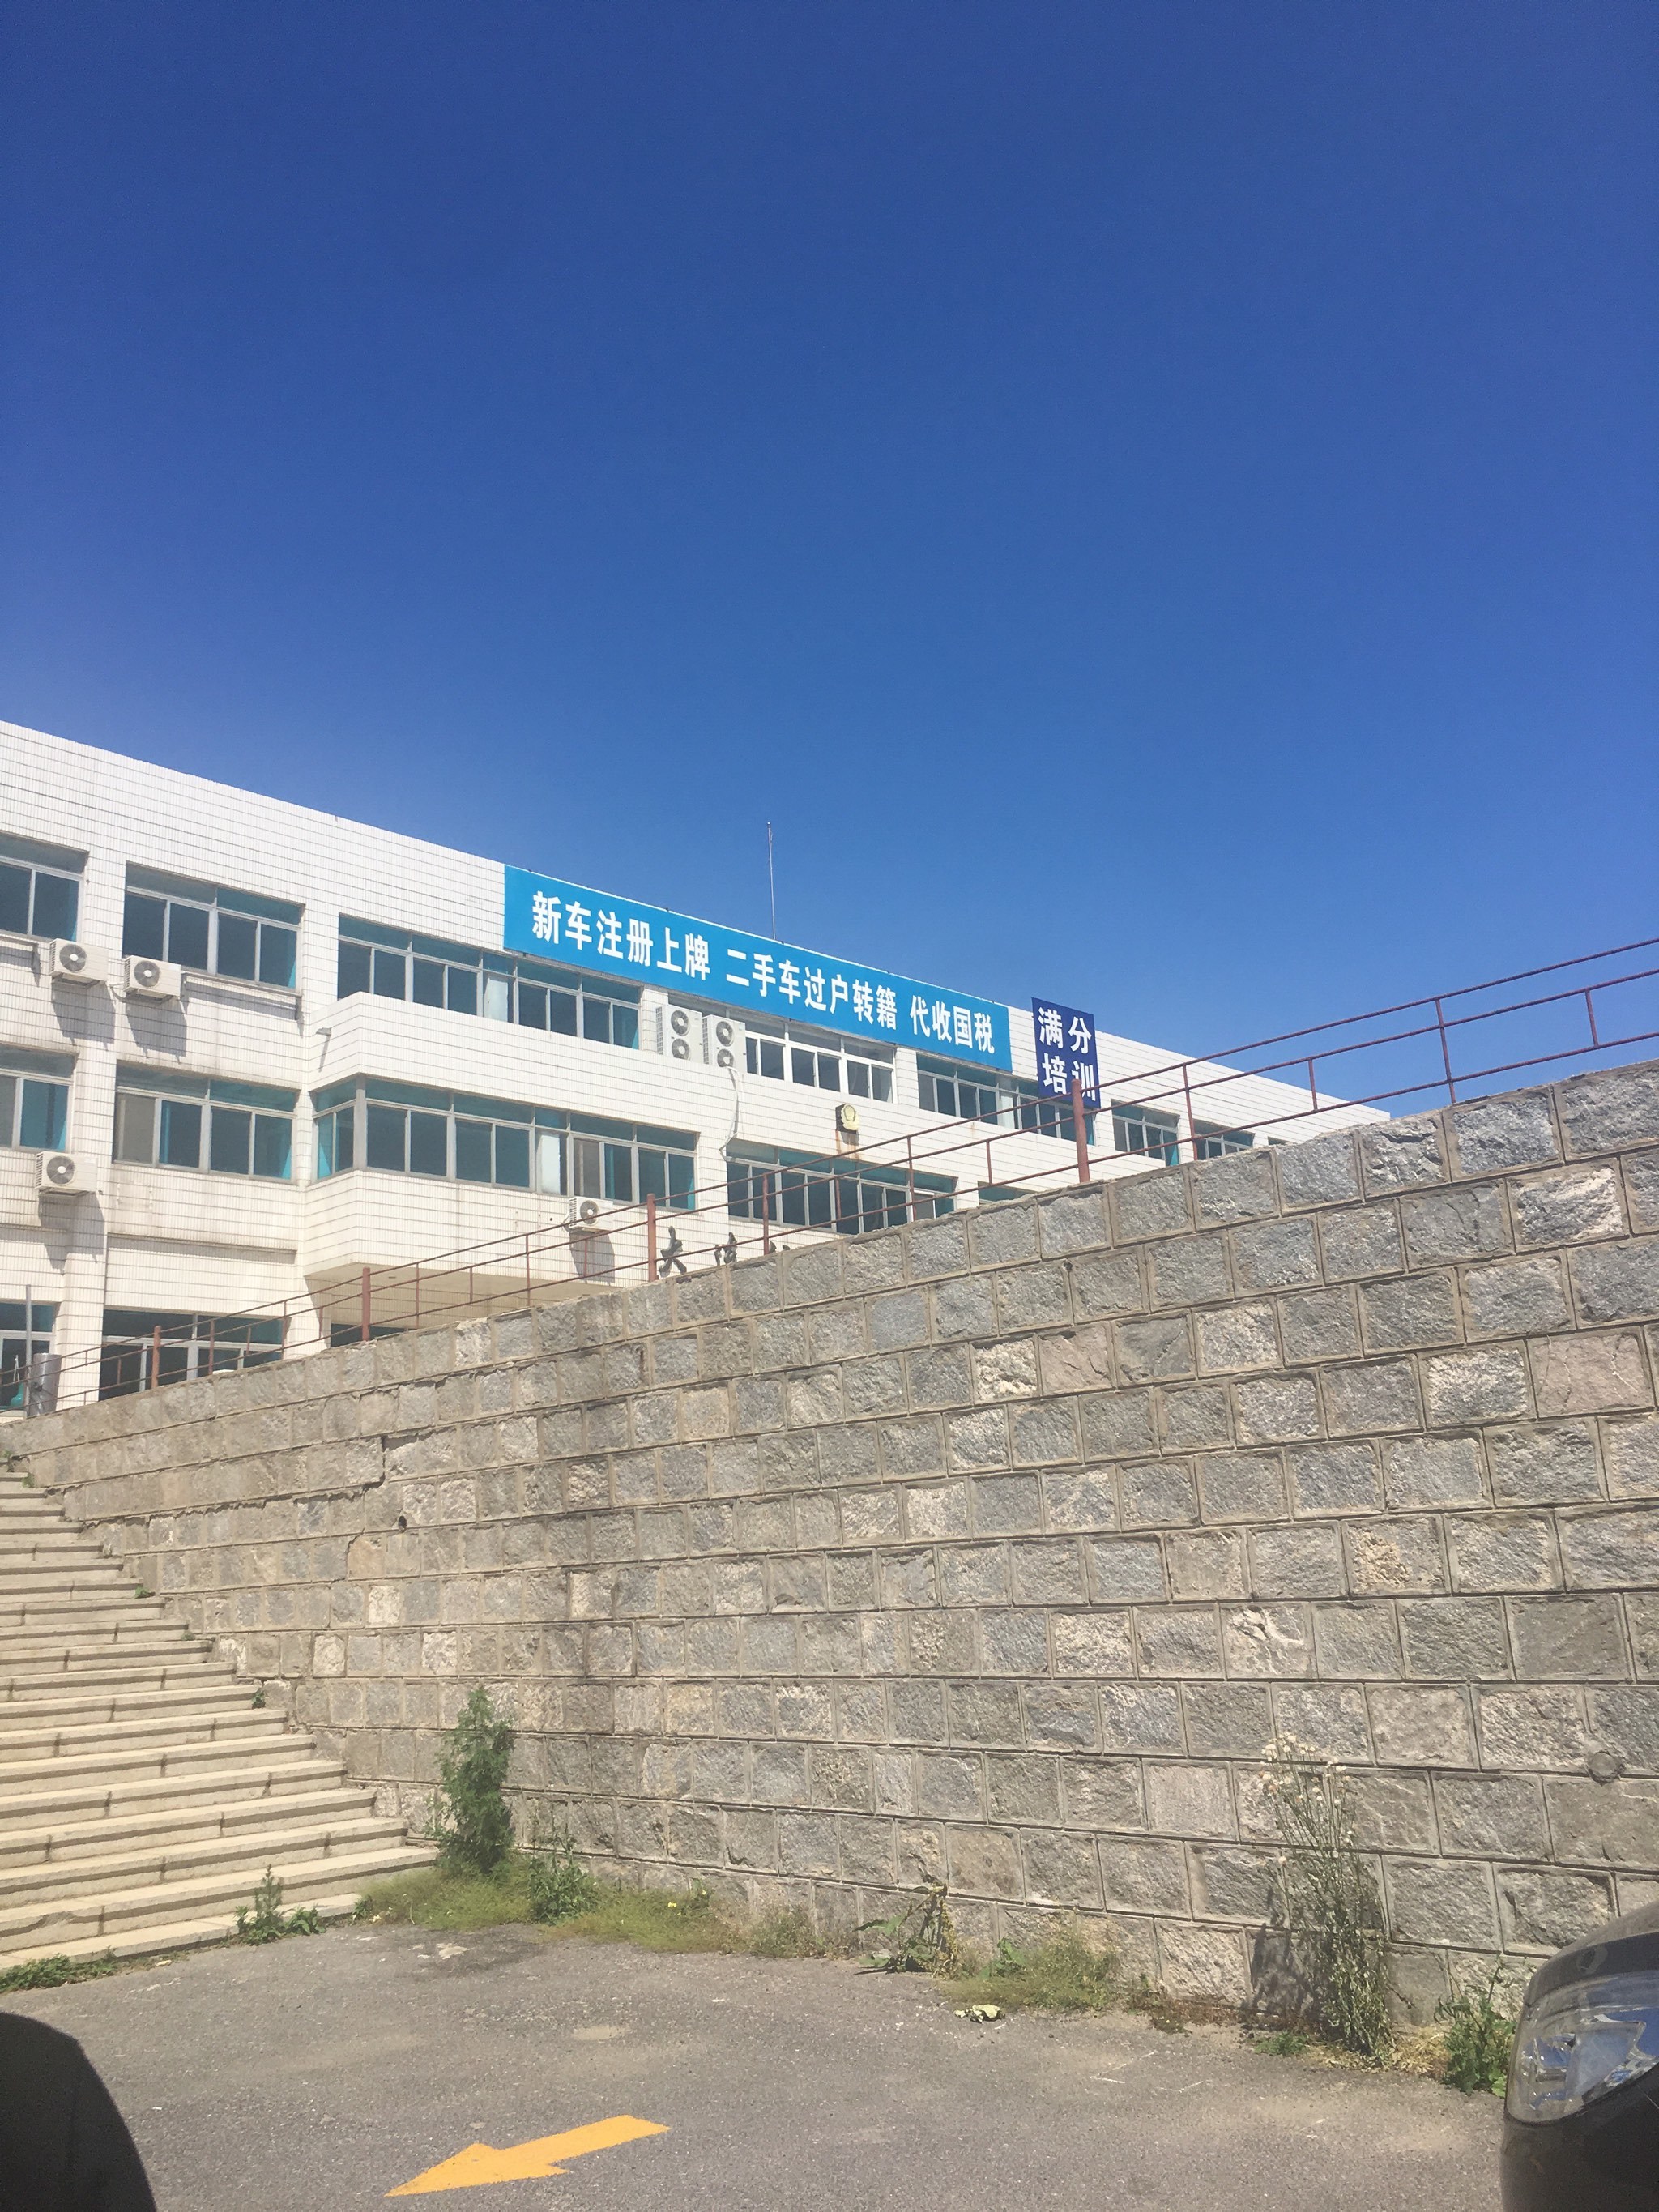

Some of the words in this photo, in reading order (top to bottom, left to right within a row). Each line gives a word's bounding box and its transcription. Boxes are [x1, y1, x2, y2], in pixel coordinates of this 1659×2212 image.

[531, 891, 710, 980] 新车注册上牌
[726, 948, 897, 1031] 二手车过户转籍
[909, 994, 995, 1054] 代收国税
[1038, 1006, 1092, 1054] 满分
[1041, 1053, 1096, 1101] 培训
